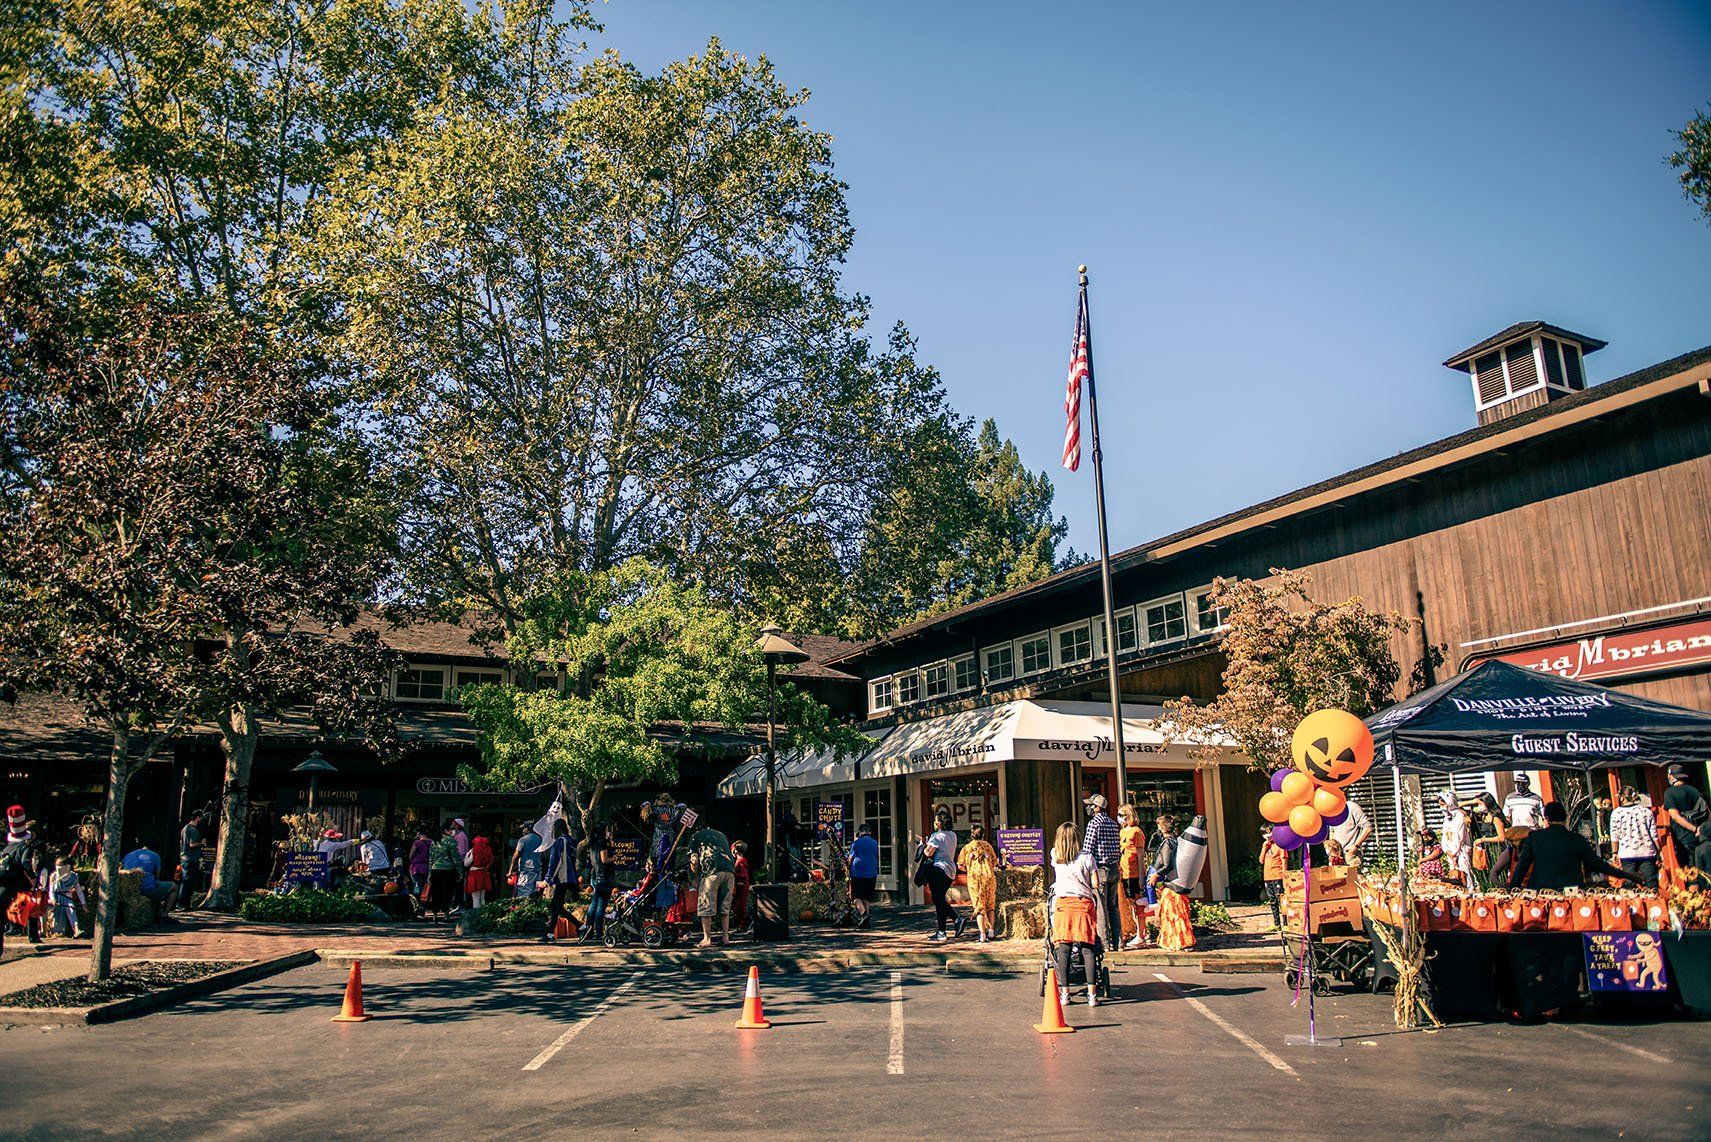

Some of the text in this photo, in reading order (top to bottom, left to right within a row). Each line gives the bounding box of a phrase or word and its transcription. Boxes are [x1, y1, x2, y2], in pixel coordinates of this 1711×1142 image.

[1608, 634, 1711, 661] brian
[1452, 692, 1613, 712] DANVILLE LIVERY
[1038, 740, 1094, 751] david
[1121, 743, 1169, 753] rian
[1511, 732, 1638, 753] GUEST SERVICES
[911, 750, 944, 764] david
[957, 744, 996, 757] brian
[1592, 935, 1612, 944] KEEP
[1594, 954, 1615, 962] TAKE
[1597, 962, 1621, 970] TREAT
